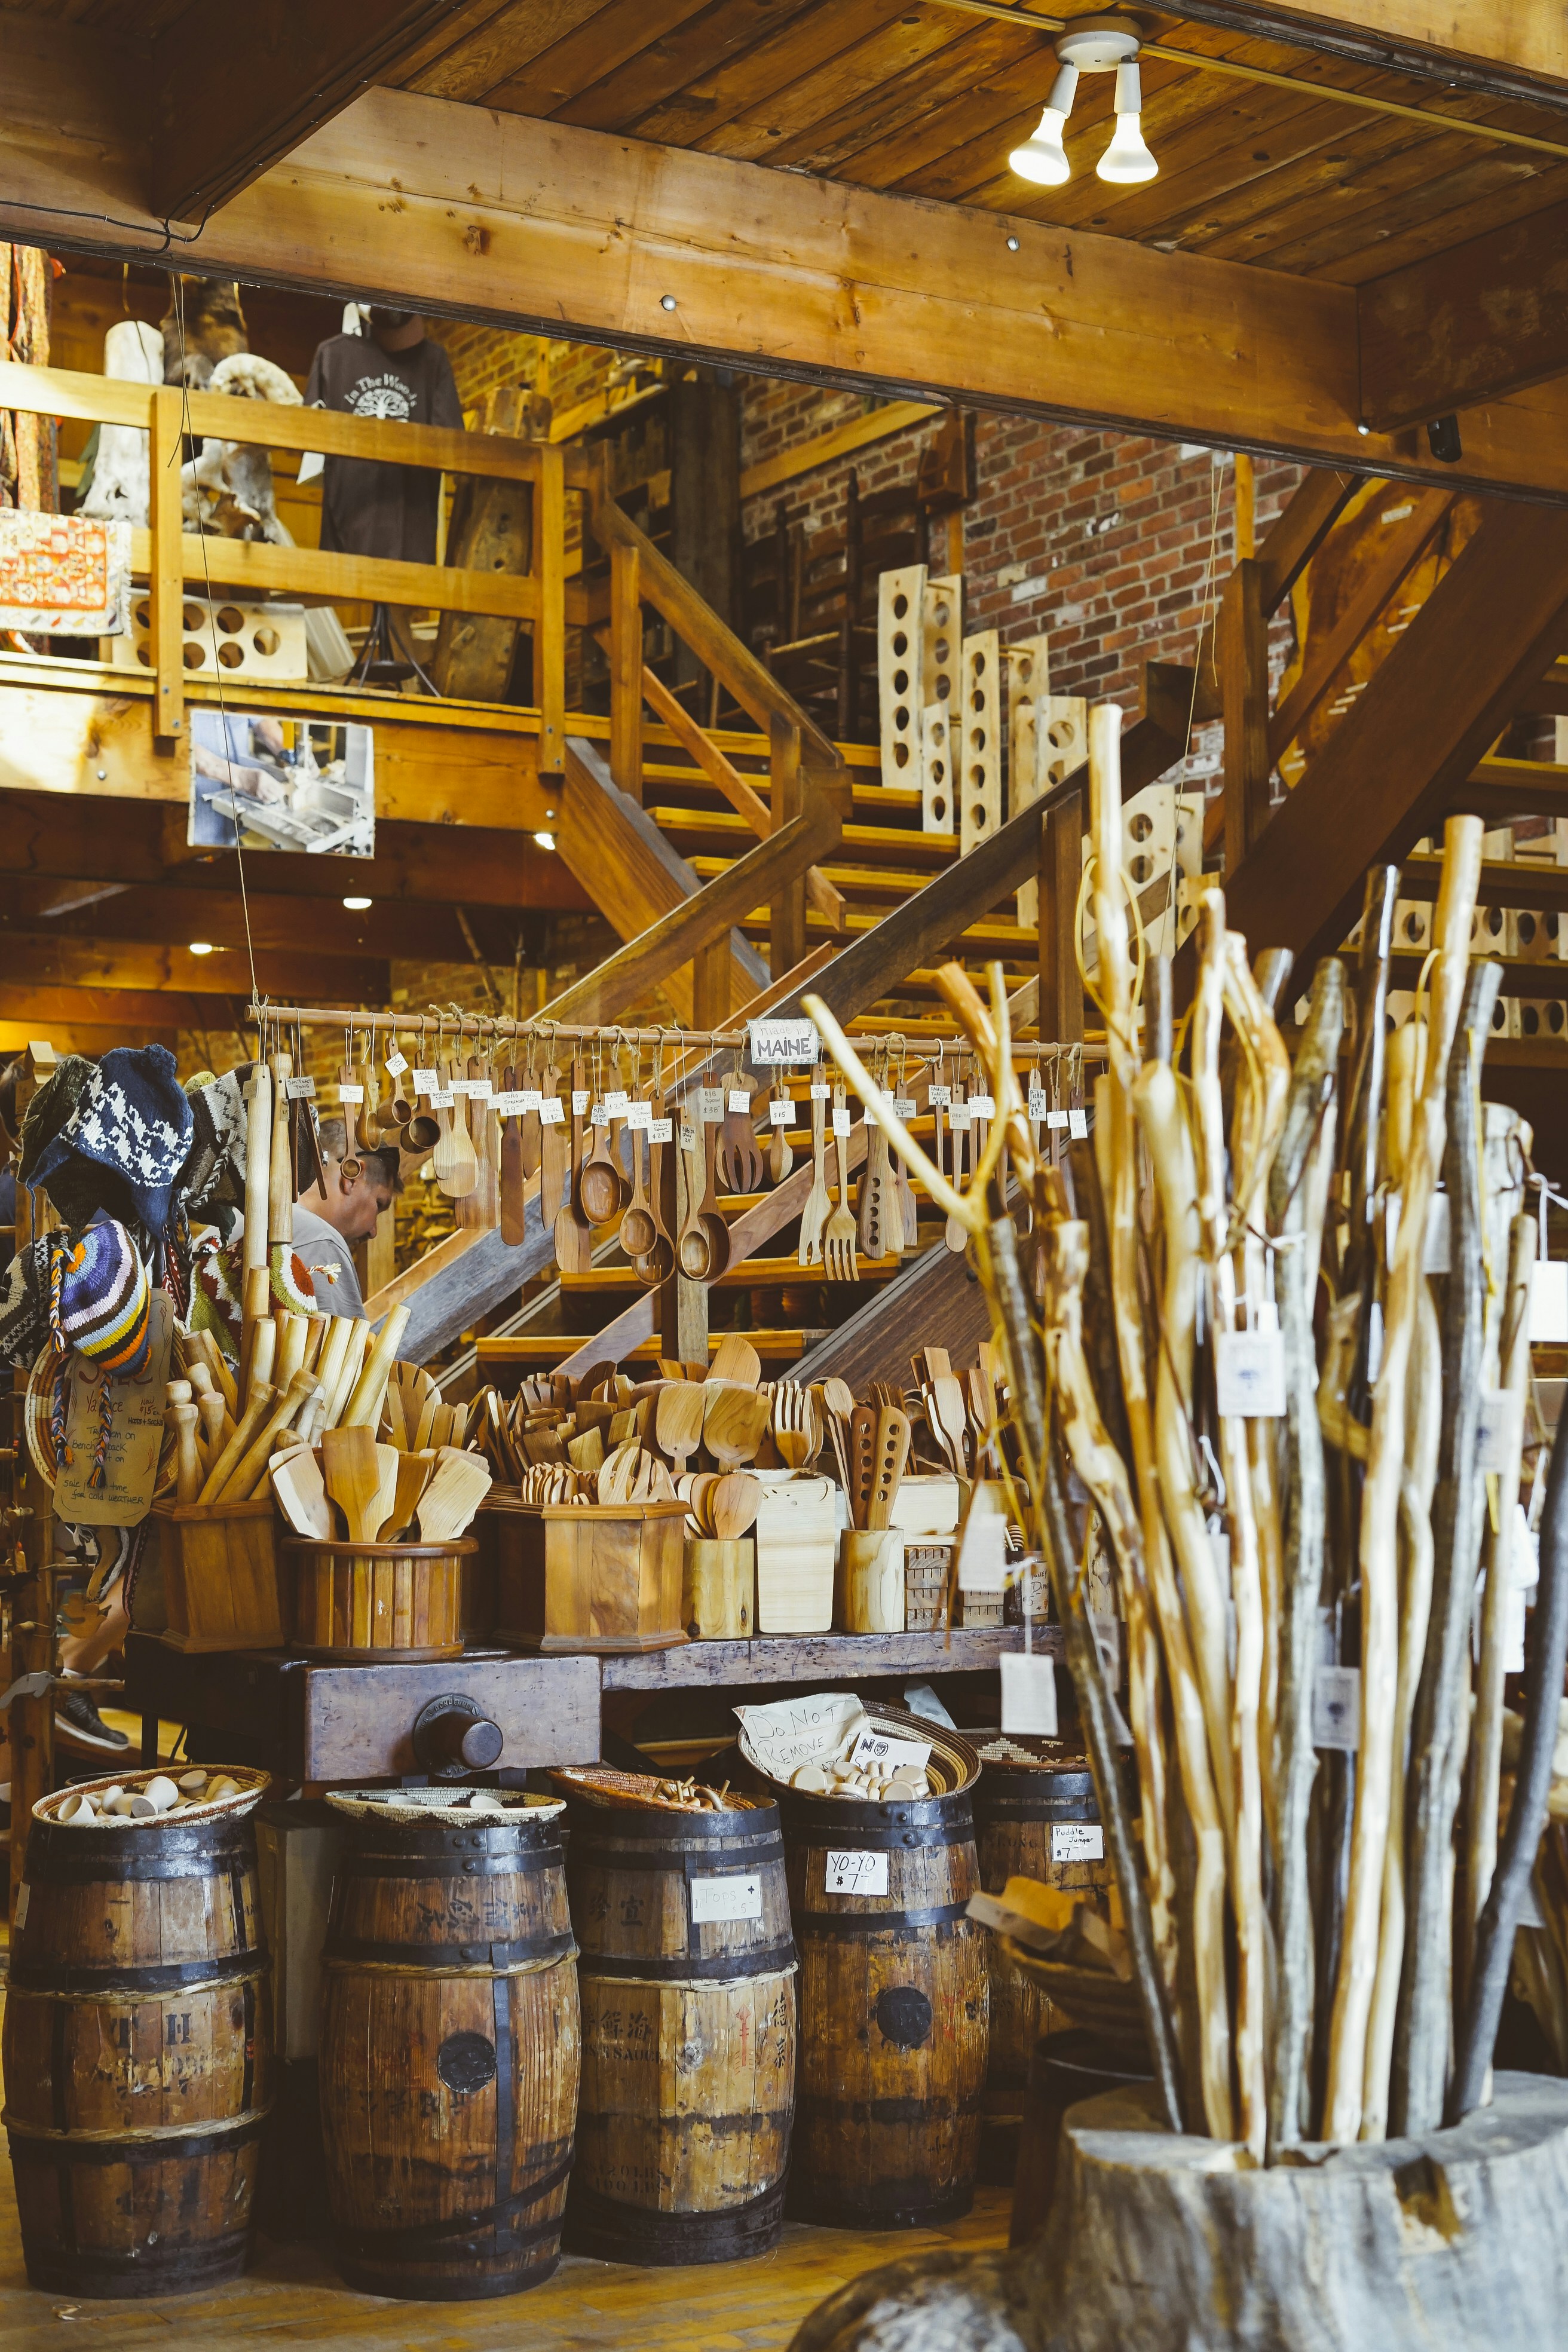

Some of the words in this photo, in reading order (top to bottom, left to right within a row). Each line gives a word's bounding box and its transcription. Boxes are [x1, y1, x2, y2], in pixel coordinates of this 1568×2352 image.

[344, 390, 360, 405] In
[356, 376, 382, 391] The
[760, 1023, 792, 1035] made
[795, 1025, 806, 1035] in
[1030, 1089, 1044, 1099] Pickle
[140, 1396, 155, 1405] Now
[125, 1431, 136, 1441] on
[72, 1439, 96, 1450] Bench
[108, 1443, 128, 1453] back
[63, 1479, 81, 1487] sale
[749, 1714, 785, 1738] Do
[757, 1735, 825, 1765] REMOVE
[1055, 1827, 1085, 1836] Puddle
[831, 1854, 876, 1873] YO-YO
[699, 1888, 737, 1906] Tops
